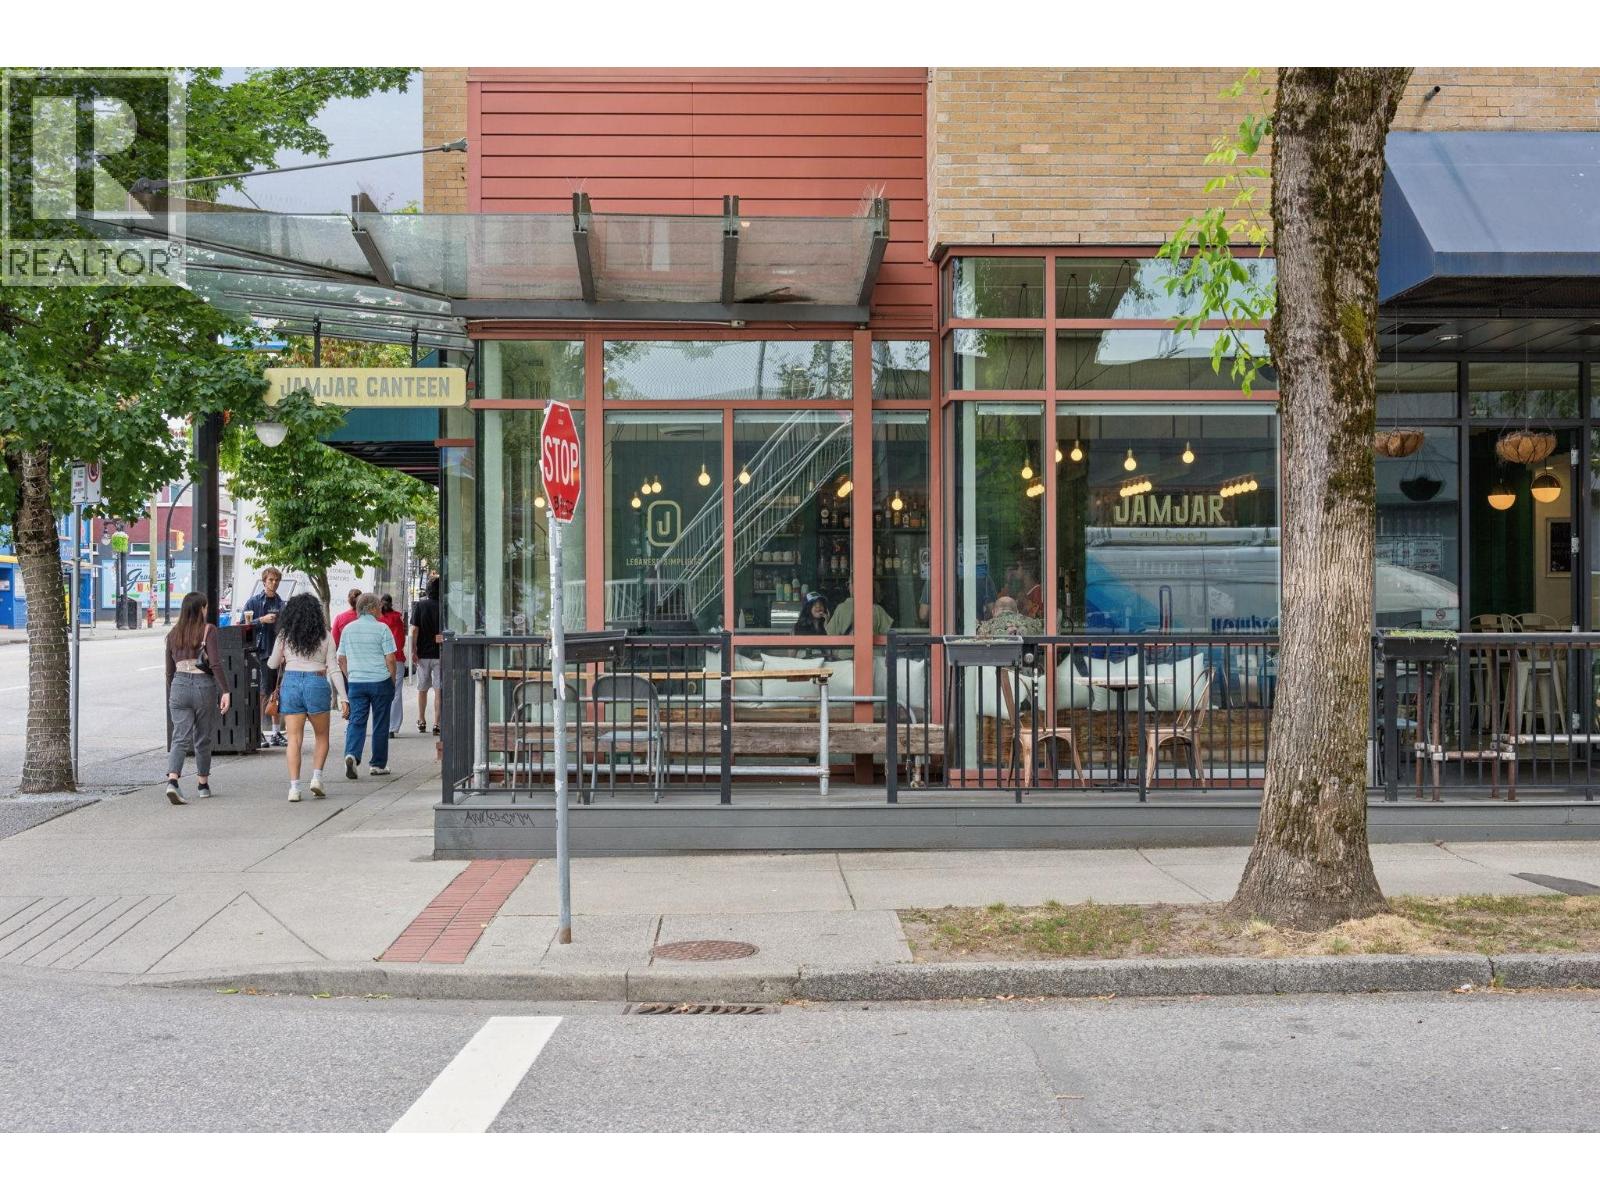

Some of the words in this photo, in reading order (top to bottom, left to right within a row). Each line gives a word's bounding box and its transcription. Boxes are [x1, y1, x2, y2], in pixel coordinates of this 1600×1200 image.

[280, 376, 359, 398] JAMJAR
[366, 376, 450, 398] CANTEEN
[544, 435, 578, 486] STOP
[1114, 494, 1225, 524] JAMJAR
[656, 511, 670, 535] J
[626, 558, 660, 566] LEBANES
